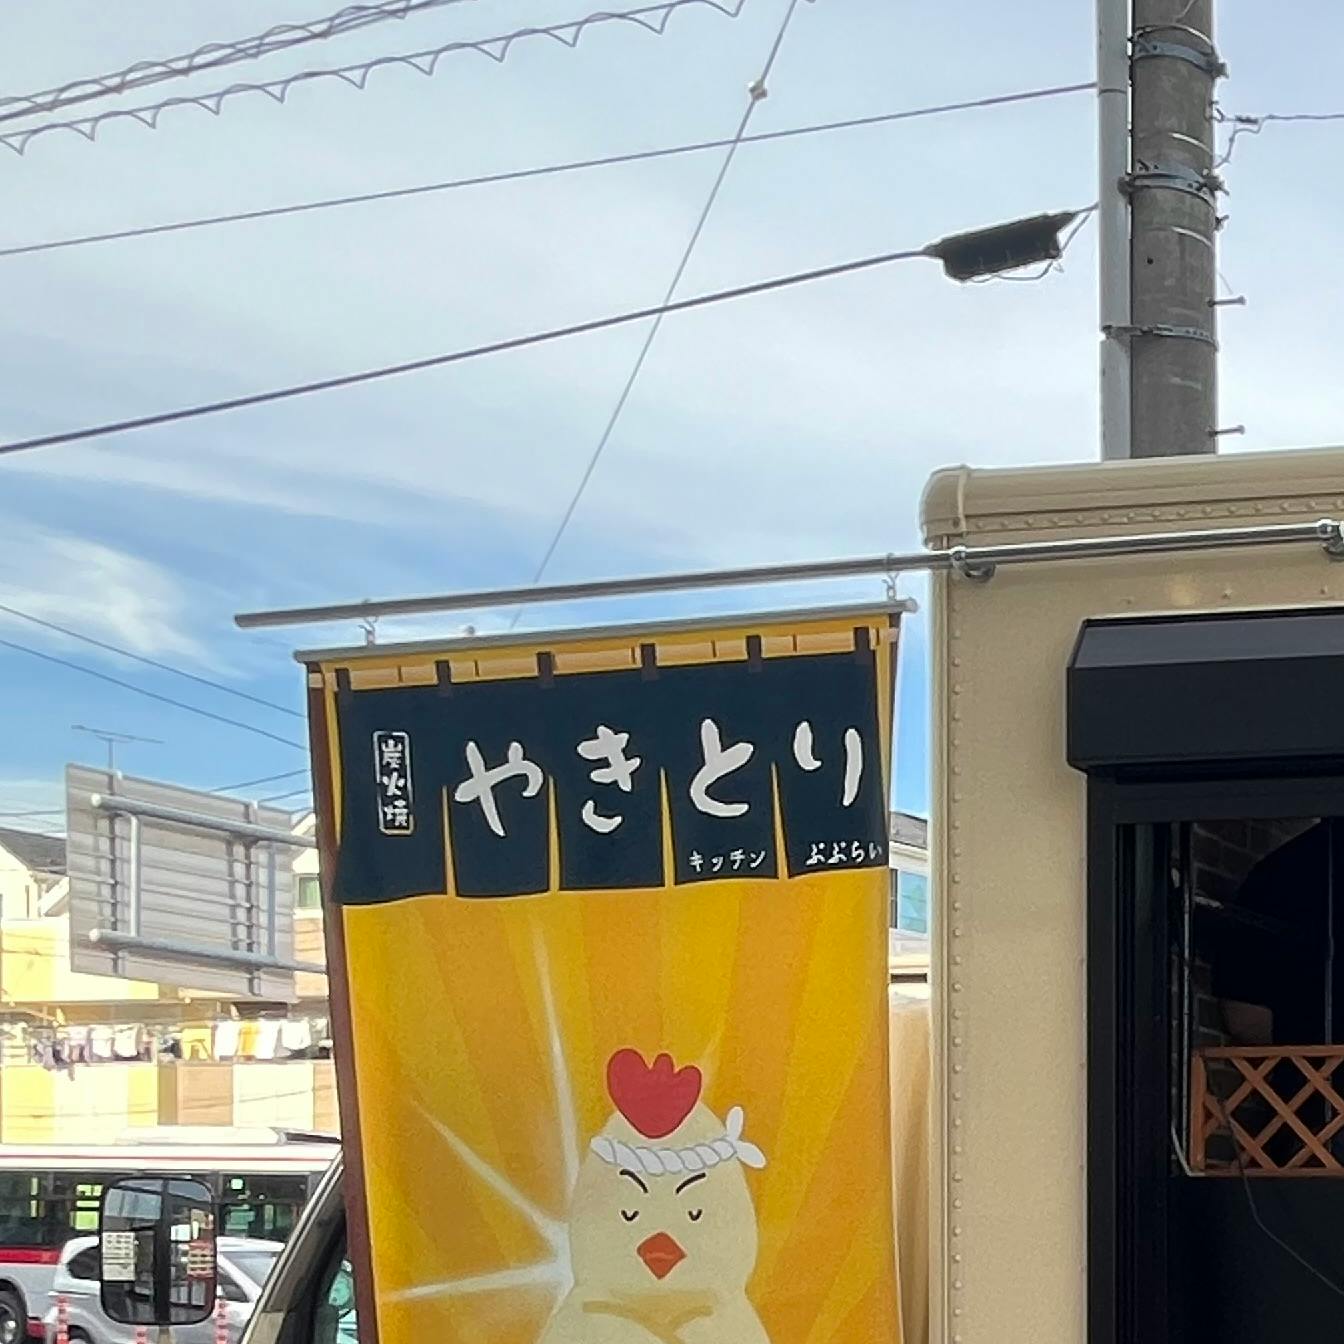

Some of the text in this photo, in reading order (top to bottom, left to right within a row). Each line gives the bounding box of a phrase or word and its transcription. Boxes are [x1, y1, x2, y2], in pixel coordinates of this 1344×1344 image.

[380, 738, 408, 826] 炭火焼
[454, 718, 863, 837] やきとり
[689, 849, 766, 873] キッチン
